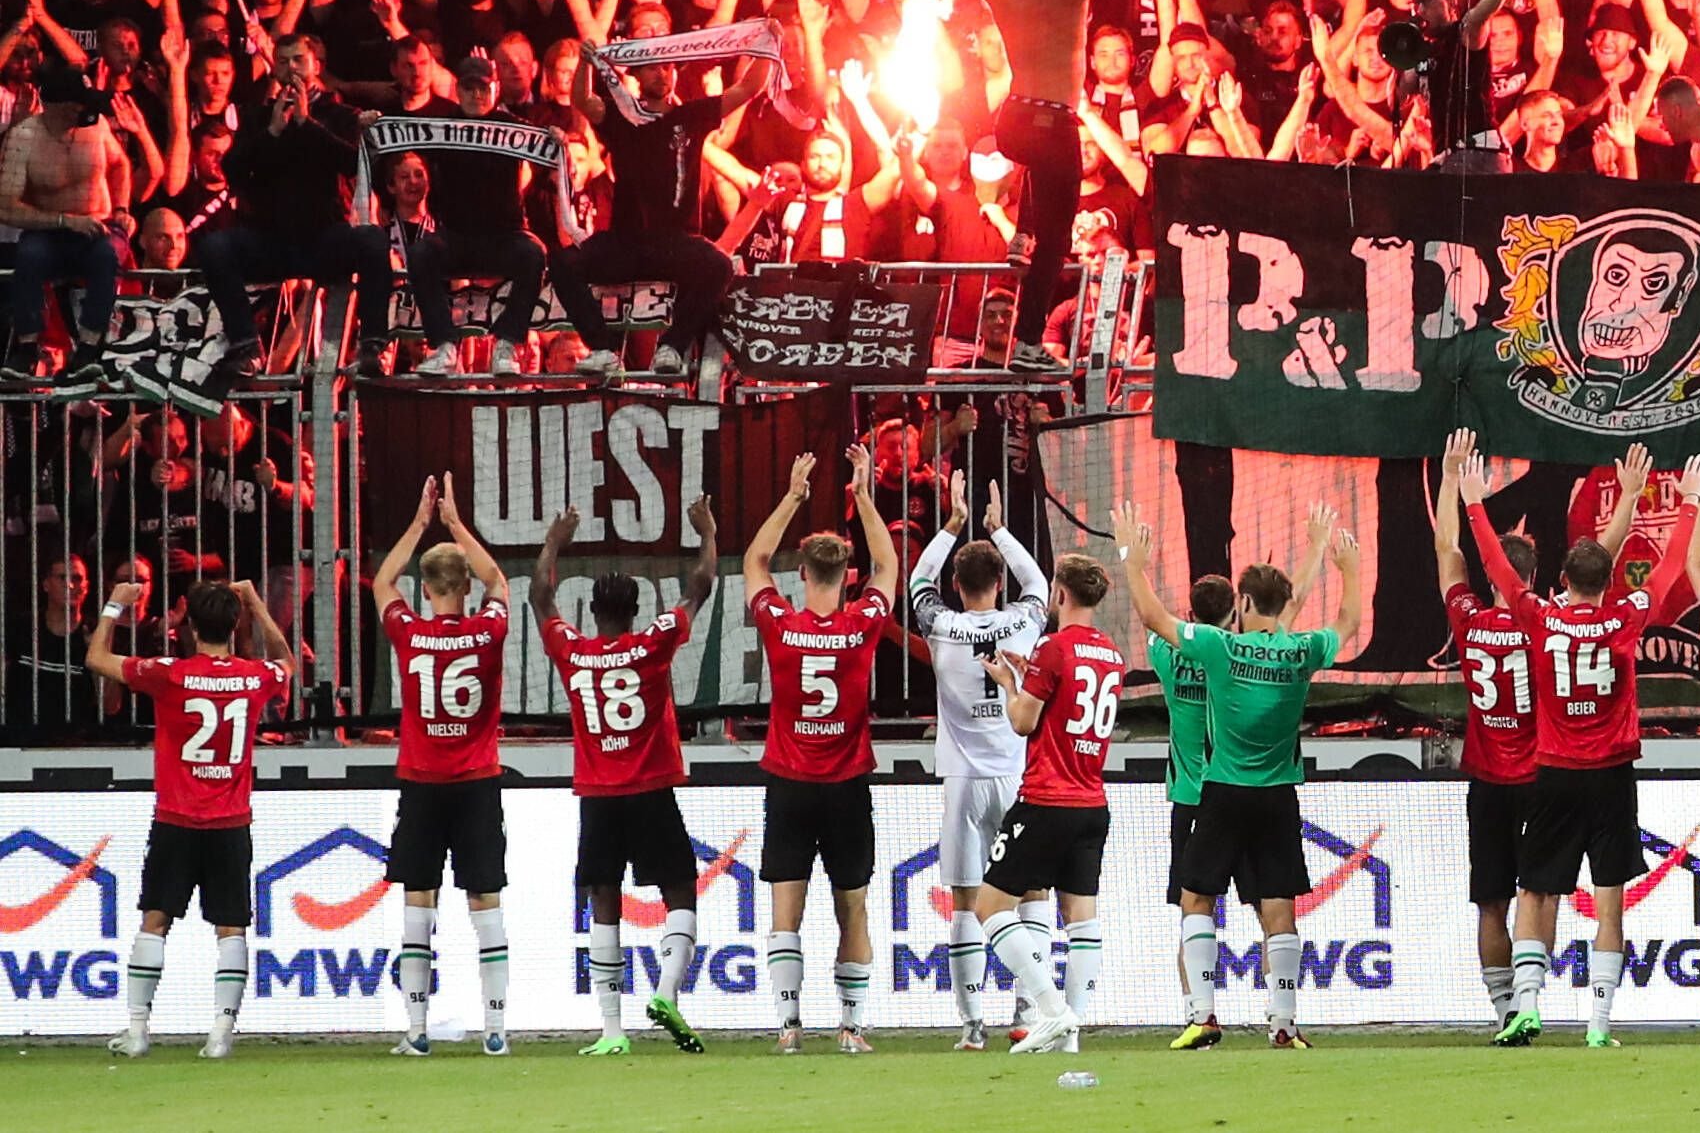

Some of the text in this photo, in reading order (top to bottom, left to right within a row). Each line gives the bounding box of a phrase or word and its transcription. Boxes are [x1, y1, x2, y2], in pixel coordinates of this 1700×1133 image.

[1526, 387, 1619, 427] HANNOVER
[1587, 391, 1606, 408] 96
[471, 401, 720, 551] WEST
[949, 617, 1028, 645] HANNOVER 96
[1466, 626, 1522, 646] HANNOVER
[1544, 616, 1622, 638] HANNOVER 96
[410, 631, 491, 650] HANNOVER 96
[781, 629, 864, 650] HANNOVER 96
[569, 644, 647, 669] HANNOVER 96
[1073, 642, 1111, 664] HANNOVER
[1233, 642, 1308, 664] macron
[1228, 660, 1294, 685] HANNOVER
[1543, 635, 1617, 698] 14
[183, 675, 261, 692] HANNOVER 96
[408, 654, 484, 721] 16
[800, 655, 840, 718] 5
[1174, 682, 1208, 701] HANN
[1465, 647, 1533, 714] 31
[569, 668, 647, 734] 18
[971, 701, 1003, 720] ZIELER
[1065, 664, 1120, 740] 36
[1567, 700, 1597, 717] BEIER
[181, 698, 249, 765] 21
[426, 722, 468, 738] NIELSEN
[793, 719, 846, 737] NEUMANN
[600, 736, 630, 753] KÖHN
[0, 949, 120, 999] WG
[1213, 939, 1393, 990] MWG
[966, 984, 984, 994] 96
[1278, 978, 1295, 990] 96
[410, 992, 426, 1003] 96
[489, 999, 504, 1011] 96
[781, 990, 797, 1001] 96
